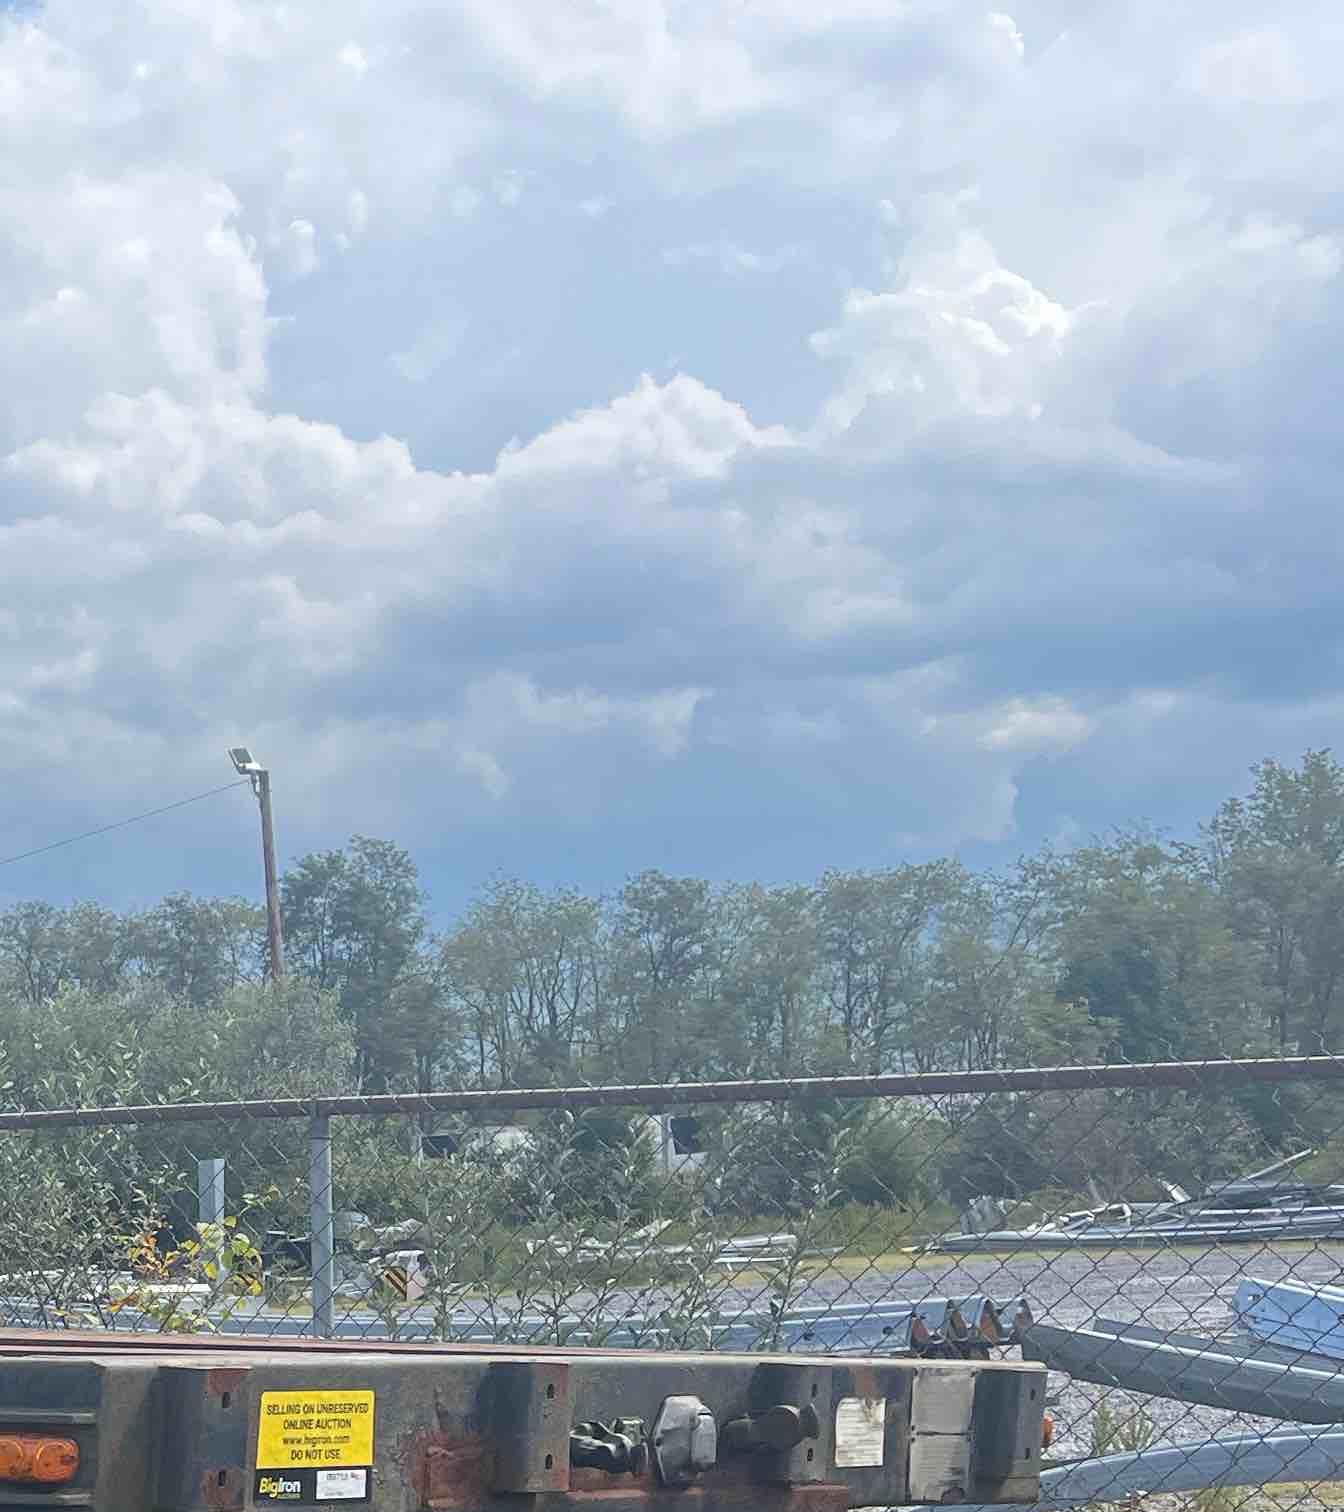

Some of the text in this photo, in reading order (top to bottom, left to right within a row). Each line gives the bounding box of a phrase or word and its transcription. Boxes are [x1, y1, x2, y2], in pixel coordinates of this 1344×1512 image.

[267, 1402, 369, 1415] SELLING ON UNRESERVED
[283, 1418, 352, 1430] ONLINE AUCTION
[291, 1448, 341, 1460] DO NOT USE
[259, 1477, 301, 1498] BigIron
